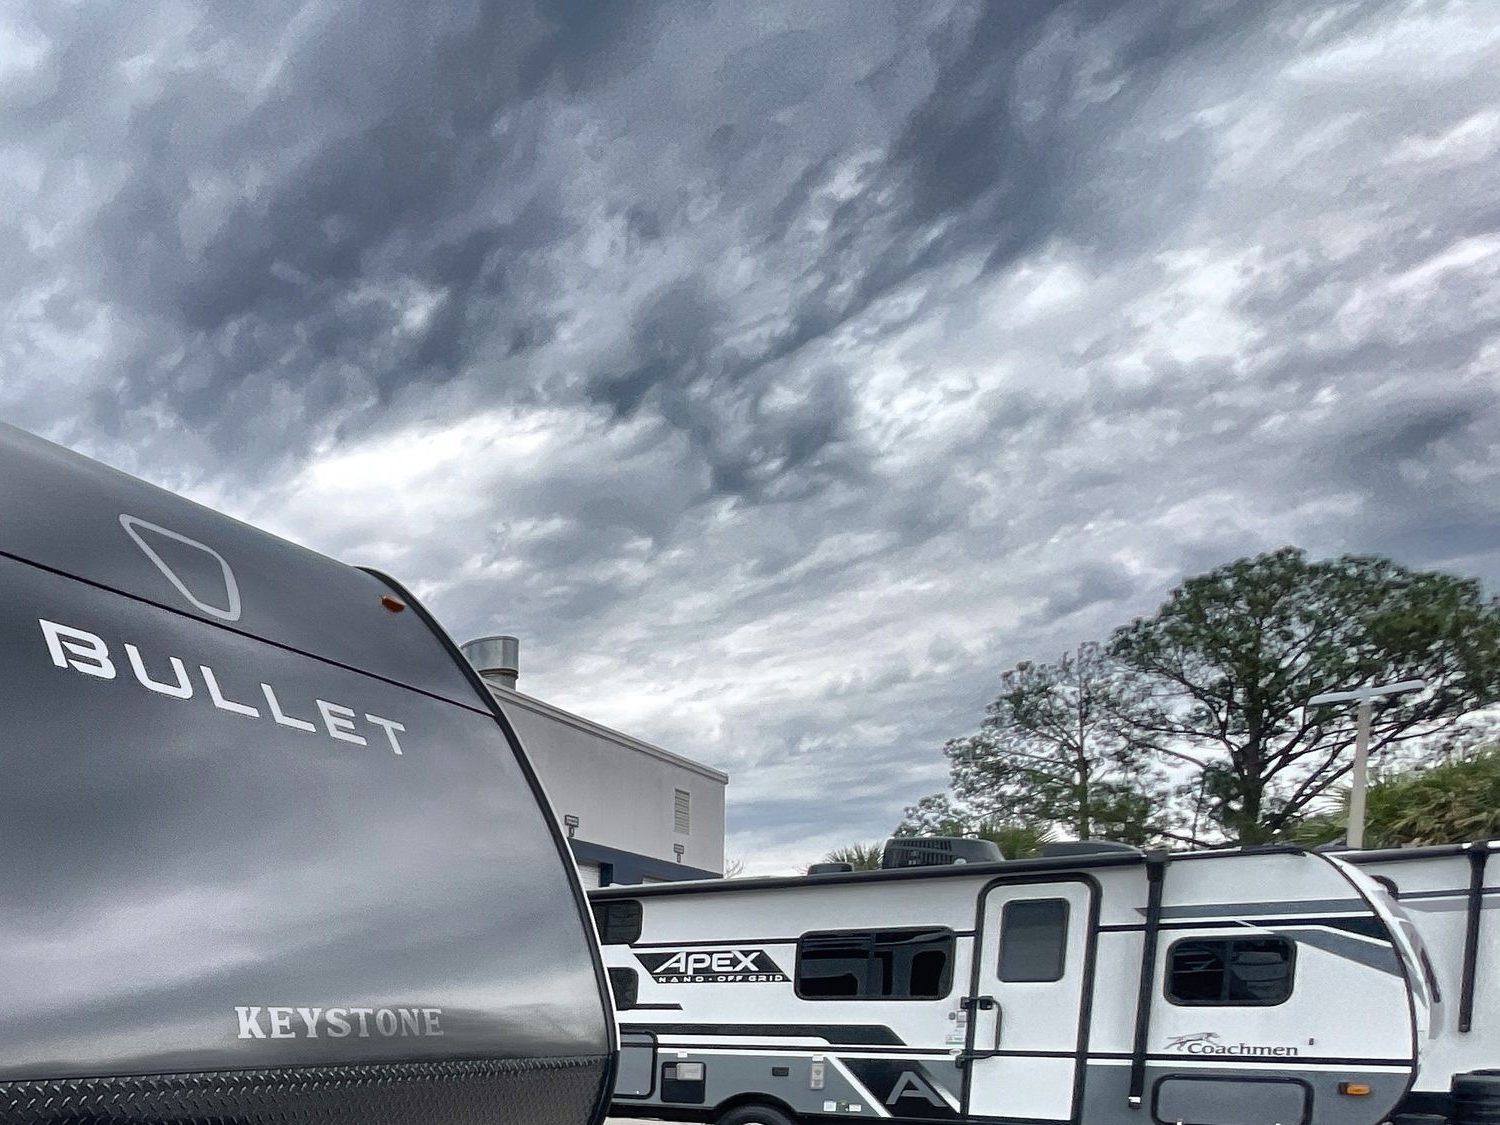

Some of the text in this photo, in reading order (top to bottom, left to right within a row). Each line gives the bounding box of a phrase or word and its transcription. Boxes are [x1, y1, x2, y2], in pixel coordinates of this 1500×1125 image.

[38, 618, 406, 755] BULLET
[653, 950, 760, 976] APEX
[717, 975, 744, 983] OFF
[748, 974, 783, 982] GRID
[235, 1006, 444, 1039] KEYSTONE
[1187, 1042, 1298, 1056] Coachmen
